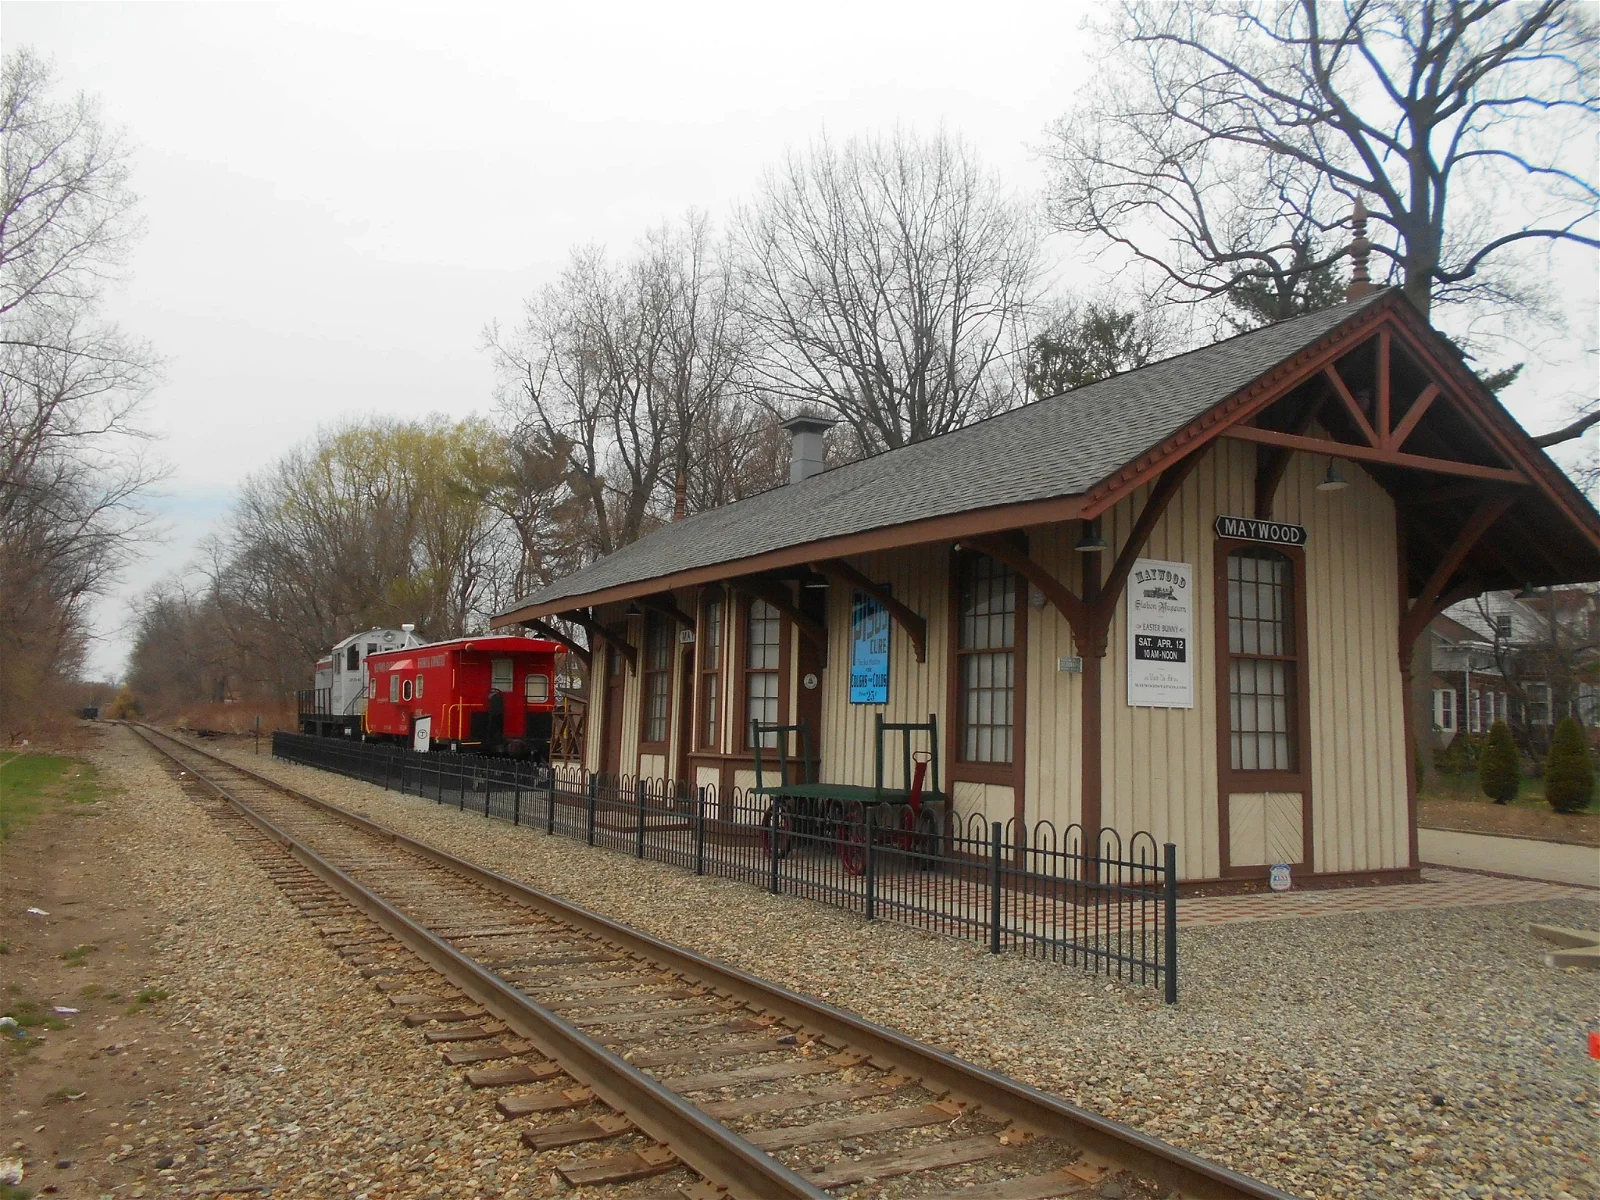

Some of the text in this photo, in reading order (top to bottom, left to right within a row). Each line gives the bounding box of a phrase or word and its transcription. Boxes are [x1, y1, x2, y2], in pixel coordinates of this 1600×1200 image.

[1225, 518, 1300, 543] MAYWOOD
[1135, 568, 1187, 589] MAYWOOD
[1135, 599, 1187, 613] Station Museum
[1142, 623, 1179, 633] EASTER BUNNY
[870, 637, 887, 654] CURE
[1138, 637, 1184, 649] SAT. APR. 12
[872, 673, 887, 687] COLDS
